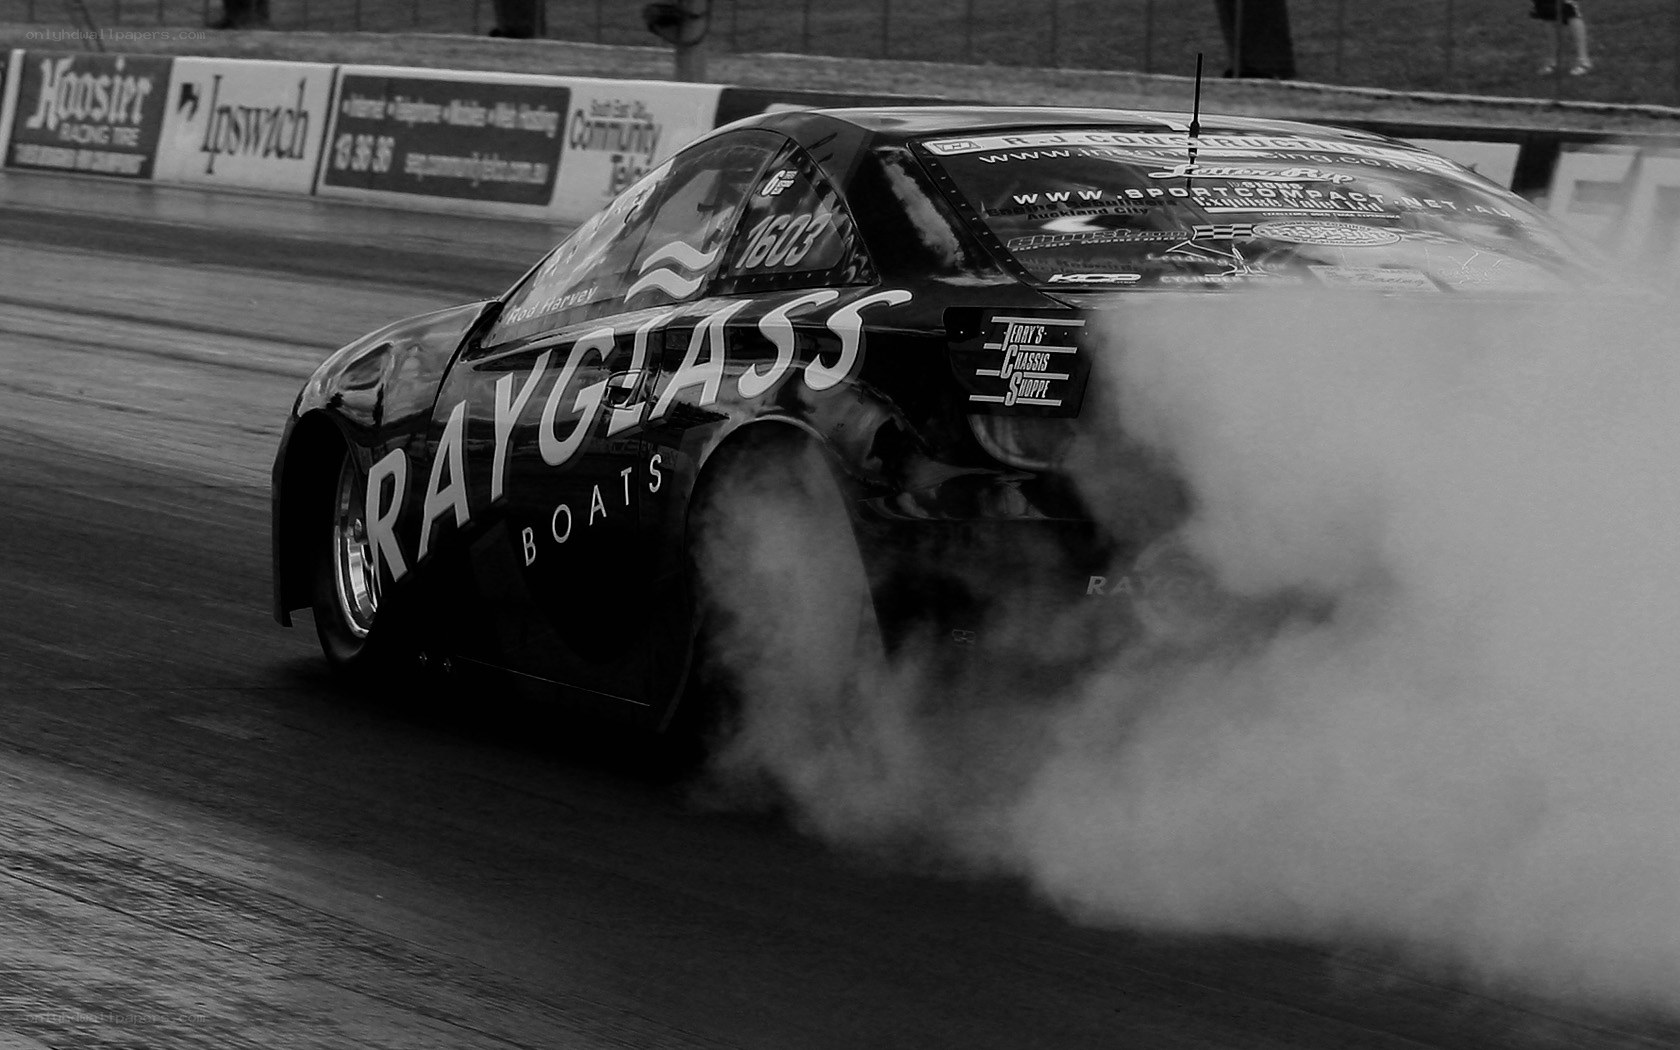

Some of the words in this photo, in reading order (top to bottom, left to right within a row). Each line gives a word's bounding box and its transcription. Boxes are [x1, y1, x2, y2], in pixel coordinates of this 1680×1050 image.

[26, 56, 153, 131] Hoosier
[200, 74, 309, 175] Ipswich
[570, 109, 663, 166] Community
[734, 213, 833, 269] 1603
[1026, 205, 1110, 221] Auckland
[1113, 206, 1150, 216] City
[506, 301, 541, 325] Rod
[541, 286, 599, 314] Harvey
[1000, 344, 1051, 379] CHASSIS
[1004, 371, 1051, 406] SHOPPE
[365, 289, 914, 597] RAYGLASS
[521, 453, 663, 567] BOATS
